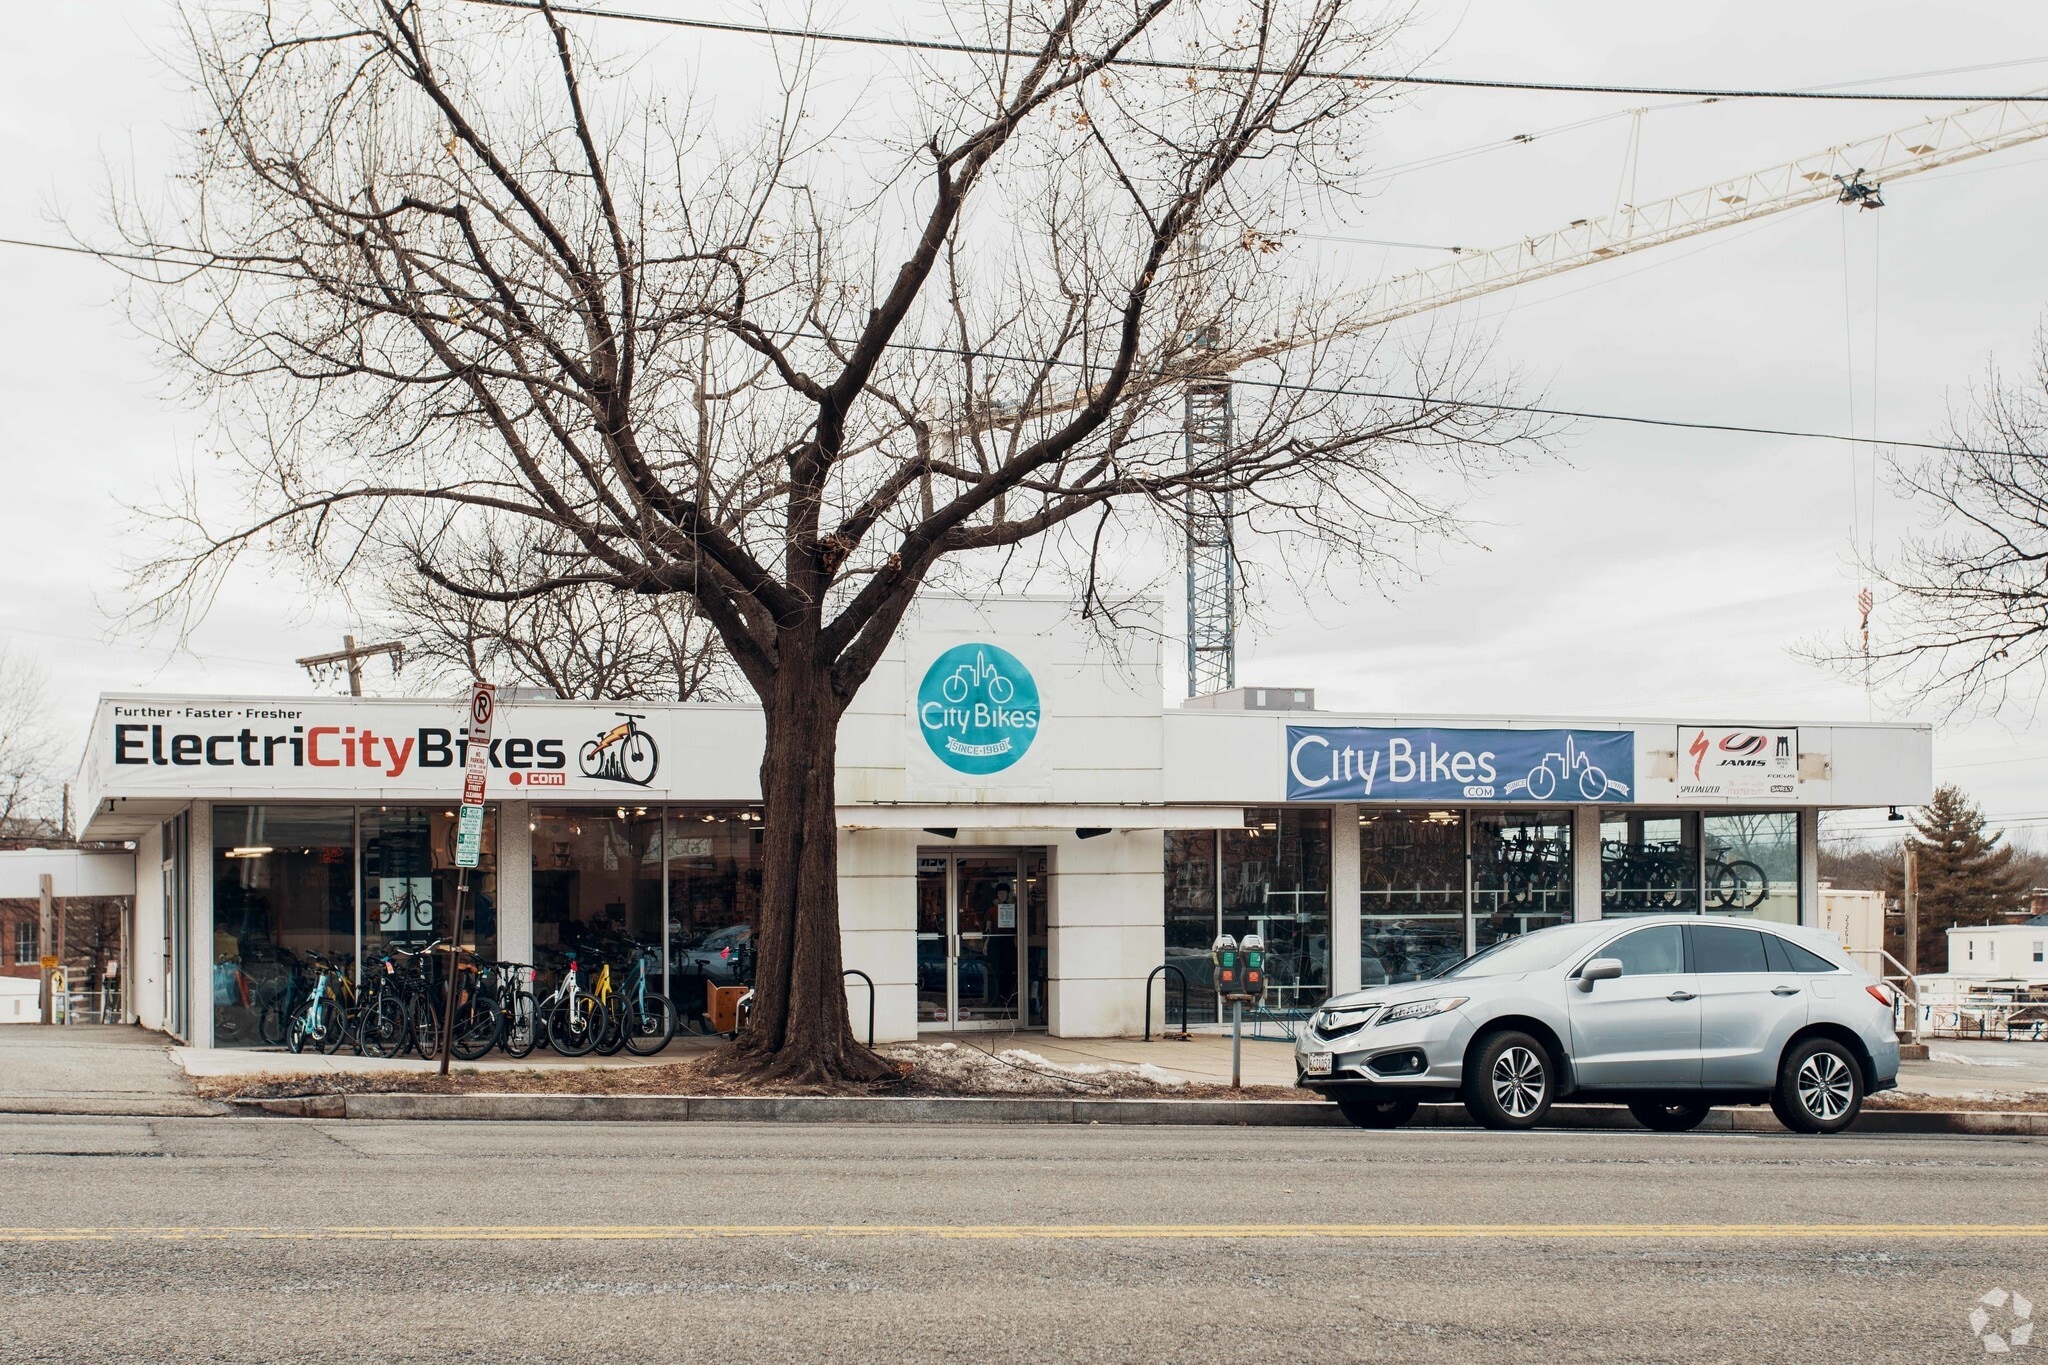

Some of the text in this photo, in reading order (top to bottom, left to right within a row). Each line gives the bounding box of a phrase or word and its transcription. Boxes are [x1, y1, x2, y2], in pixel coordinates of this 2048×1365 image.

[115, 706, 302, 719] Further Faster Fresher
[1680, 785, 1720, 793] SPECIALIZED
